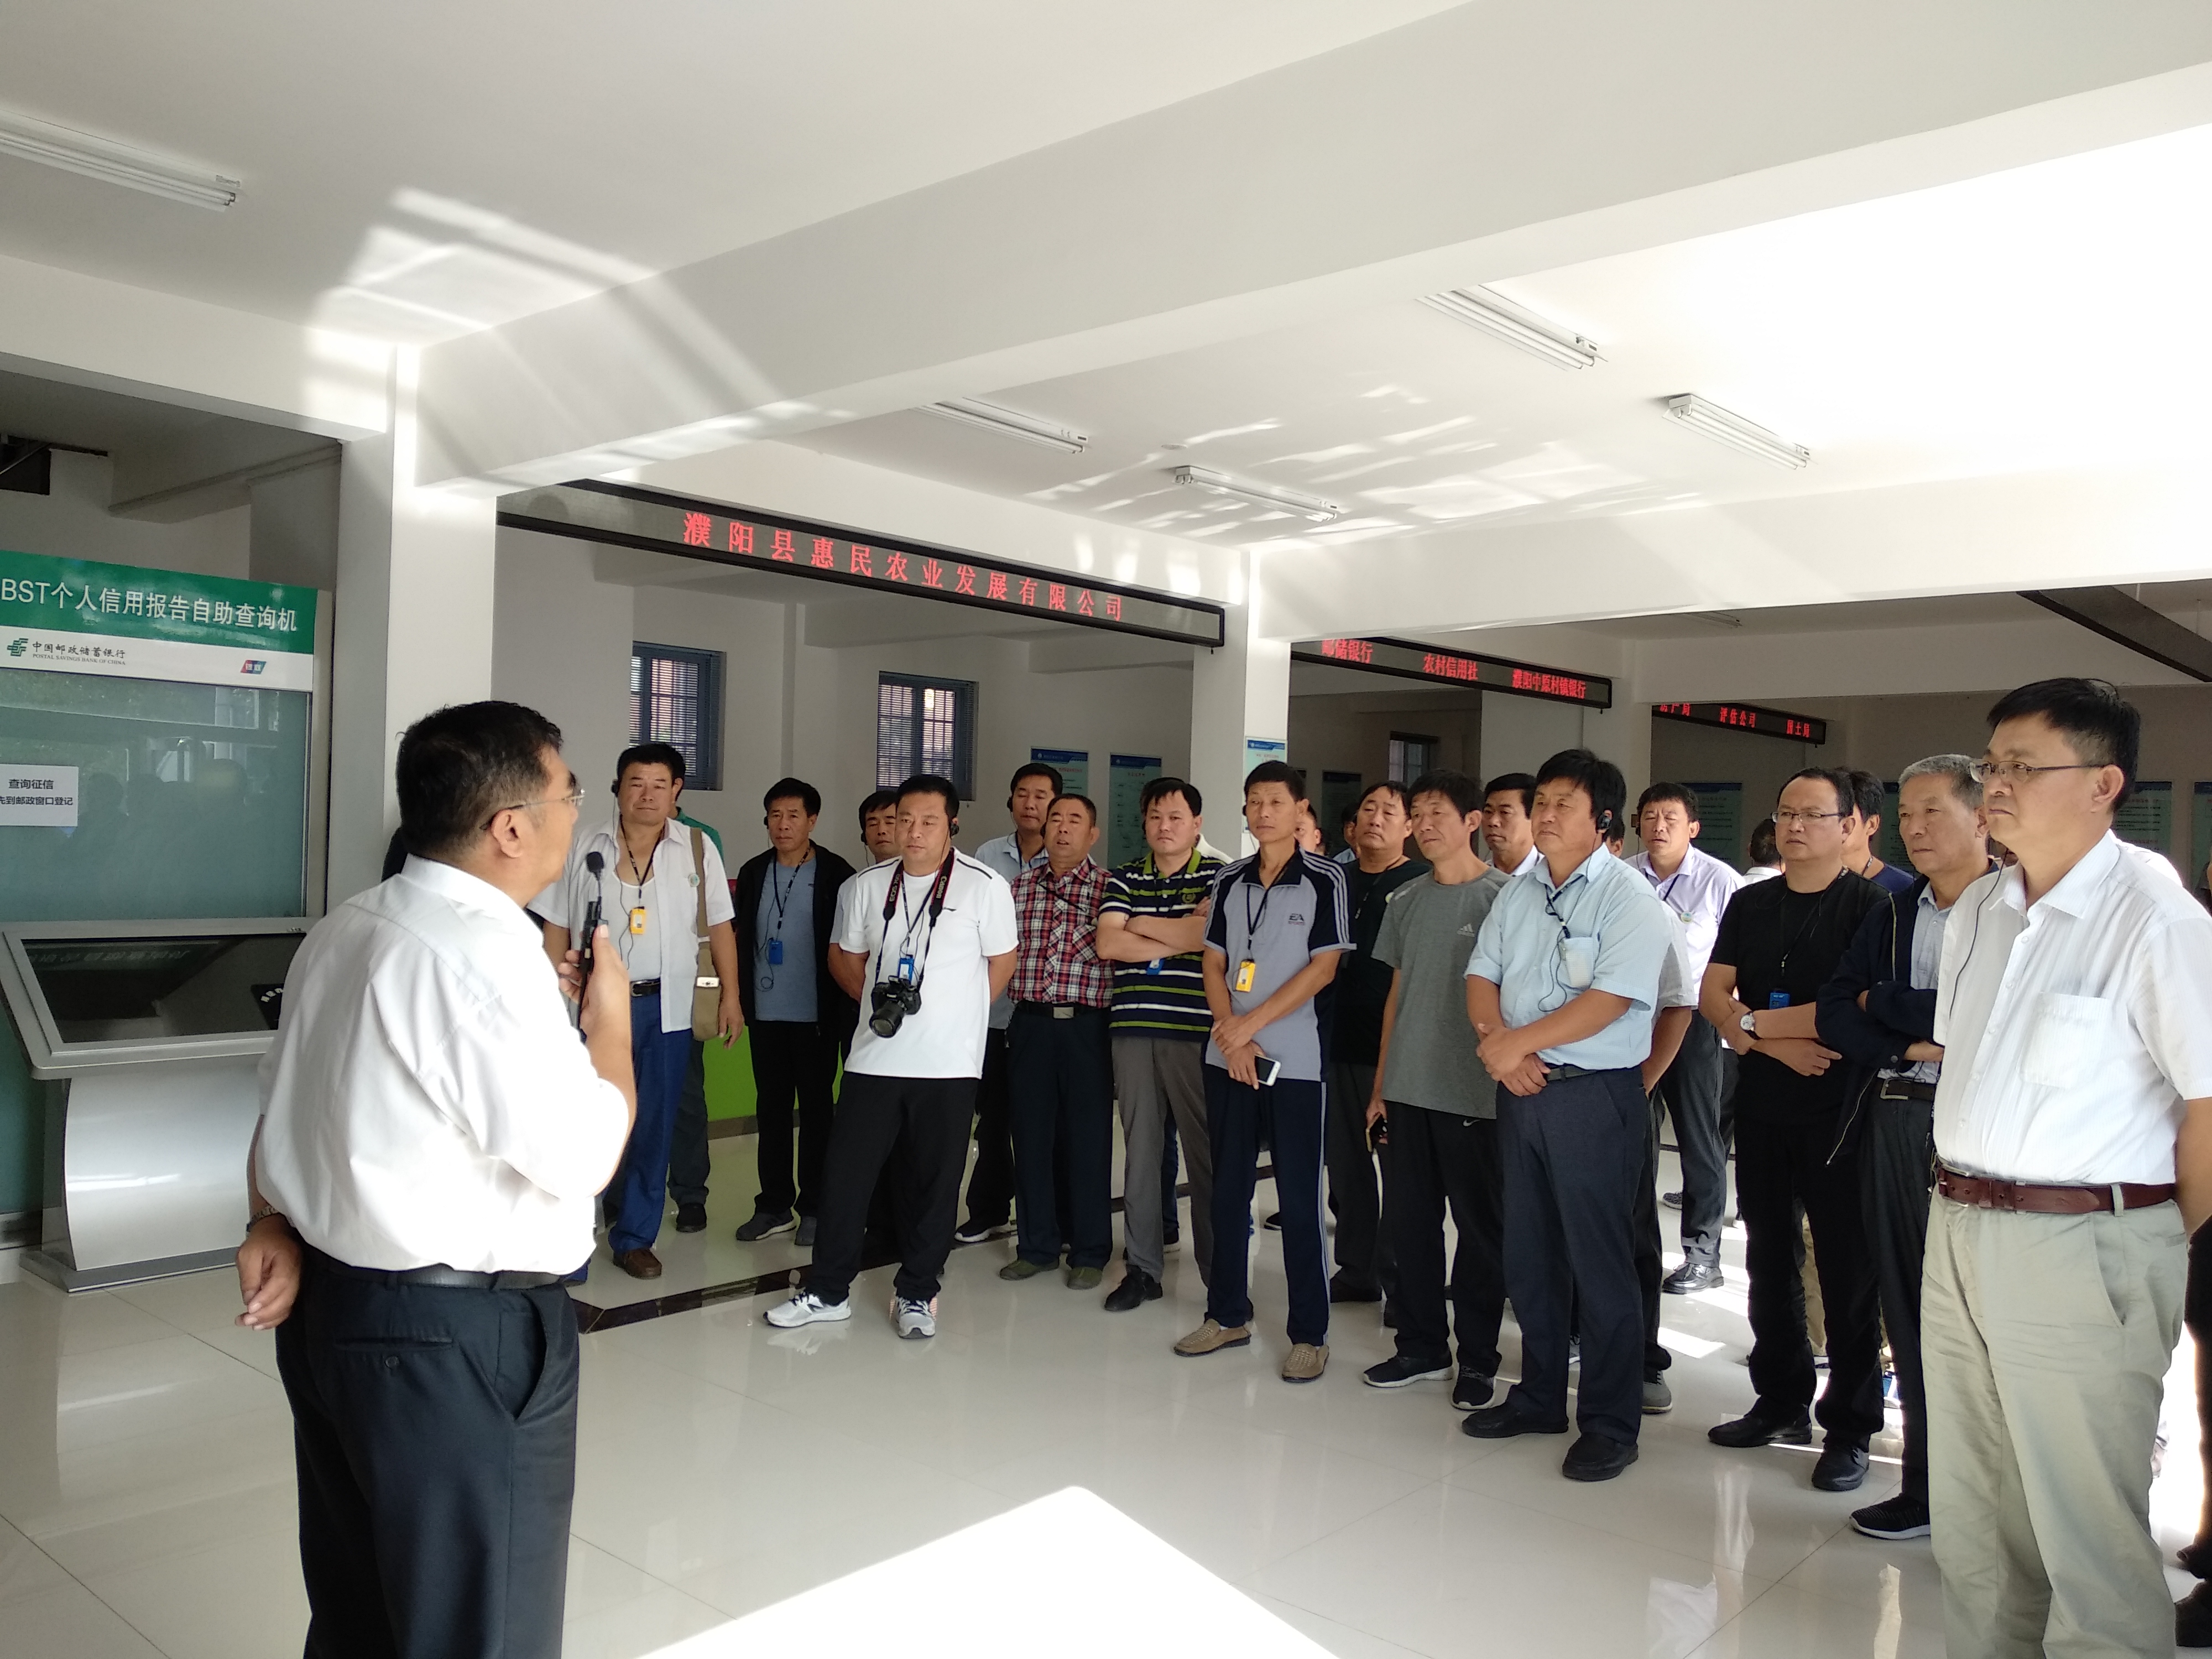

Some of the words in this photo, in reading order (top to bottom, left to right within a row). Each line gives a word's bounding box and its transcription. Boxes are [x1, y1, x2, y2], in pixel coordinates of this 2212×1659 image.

[684, 512, 1122, 621] 濮阳县惠民农业发展有限公司
[1, 578, 297, 631] BST个人信用报告自助查询机
[32, 641, 125, 658] 中国邮政储蓄银行
[1423, 653, 1478, 681] 农村信用社
[1719, 707, 1756, 728] 评估公司
[1786, 719, 1810, 738] 国土局
[9, 779, 54, 790] 查询征信
[936, 876, 947, 899] Canon
